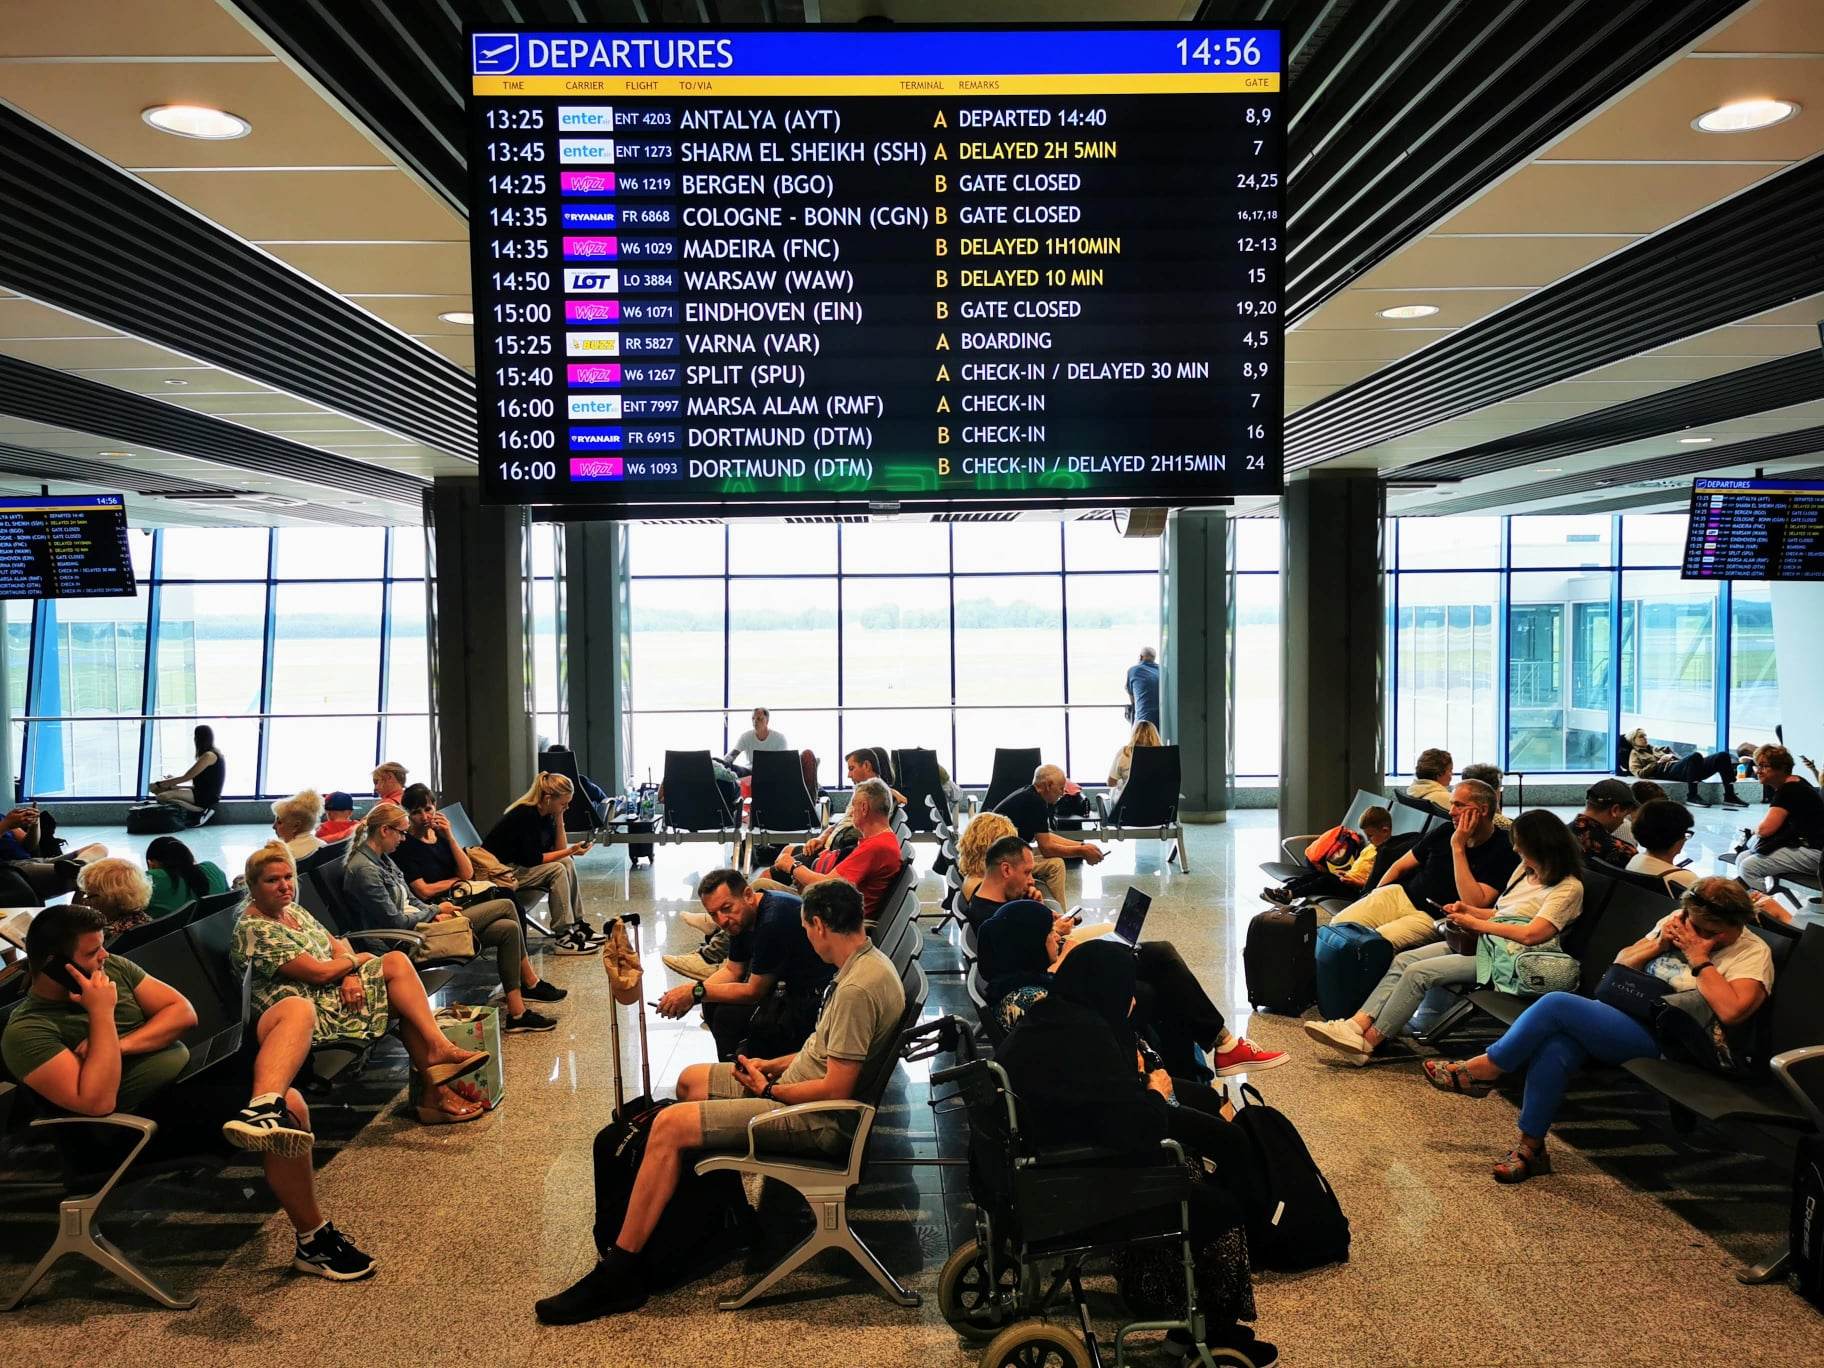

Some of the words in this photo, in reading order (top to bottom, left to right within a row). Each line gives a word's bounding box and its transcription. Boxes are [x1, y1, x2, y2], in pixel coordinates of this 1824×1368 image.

[529, 39, 732, 68] DEPARTURES
[1177, 38, 1260, 65] 14:56
[502, 81, 524, 90] TIME
[565, 81, 604, 90] CARRIER
[625, 81, 659, 90] FLIGHT
[679, 80, 713, 91] TO/VIA
[900, 81, 944, 90] TERMINAL
[959, 80, 1000, 90] REMARKS
[1245, 78, 1270, 87] GATE
[487, 110, 543, 128] 13:25
[615, 113, 639, 124] ENT
[643, 114, 671, 124] 4203
[680, 110, 776, 129] ANTALYA
[785, 110, 840, 133] (AYT)
[934, 110, 947, 128] A
[960, 110, 1051, 127] DEPARTED
[1059, 109, 1106, 126] 14:40
[1246, 108, 1271, 125] 8,9
[488, 143, 544, 161] 13:45
[616, 146, 640, 157] ENT
[645, 146, 672, 157] 1273
[682, 143, 752, 161] SHARM
[760, 143, 784, 161] EL
[791, 143, 864, 161] SHEIKH
[874, 142, 926, 165] (SSH)
[934, 143, 947, 160] A
[960, 142, 1038, 159] DELAYED
[1045, 142, 1067, 158] 2H
[1075, 142, 1116, 158] 5MIN
[1254, 141, 1263, 155] 7
[489, 175, 545, 194] 14:25
[619, 179, 638, 189] W6
[643, 179, 670, 189] 1219
[683, 175, 764, 194] BERGEN
[774, 175, 833, 198] (BGO)
[936, 175, 947, 192] B
[960, 175, 1007, 191] GATE
[1013, 174, 1080, 191] CLOSED
[1238, 174, 1277, 190] 24,25
[491, 208, 547, 226] 14:35
[570, 213, 614, 221] RYANAIR
[623, 211, 638, 222] FR
[642, 211, 670, 222] 6868
[683, 208, 781, 226] COLOGNE
[805, 207, 860, 225] BONN
[870, 207, 928, 229] (CGN)
[936, 207, 947, 224] B
[960, 207, 1007, 223] GATE
[1013, 206, 1080, 223] CLOSED
[1238, 211, 1277, 220] 16,17,18
[492, 240, 548, 258] 14:35
[621, 243, 640, 254] W6
[645, 243, 672, 254] 1029
[684, 239, 775, 258] MADEIRA
[784, 239, 839, 262] (FNC)
[936, 239, 947, 256] B
[961, 238, 1038, 255] DELAYED
[1046, 238, 1120, 254] 1H10MIN
[1238, 238, 1276, 251] 12-13
[493, 272, 549, 290] 14:50
[573, 275, 611, 289] LOT
[624, 275, 640, 286] LO
[644, 275, 672, 286] 3884
[684, 271, 776, 290] WARSAW
[785, 271, 853, 293] (WAW)
[937, 270, 948, 287] B
[961, 270, 1038, 286] DELAYED
[1046, 270, 1065, 286] 10
[1071, 269, 1103, 286] MIN
[1249, 268, 1265, 282] 15
[494, 304, 551, 322] 15:00
[623, 307, 642, 317] W6
[647, 307, 672, 317] 1071
[686, 302, 804, 321] EINDHOVEN
[814, 302, 862, 324] (EIN)
[937, 302, 948, 319] B
[961, 302, 1008, 318] GATE
[1014, 301, 1081, 317] CLOSED
[1237, 301, 1276, 317] 19,20
[496, 336, 551, 354] 15:25
[582, 339, 616, 350] BUZZ
[626, 338, 641, 349] RR
[646, 338, 673, 349] 5827
[686, 334, 756, 353] VARNA
[764, 334, 819, 356] (VAR)
[936, 333, 949, 350] A
[962, 333, 1051, 349] BOARDING
[1243, 331, 1268, 348] 4,5
[497, 367, 553, 385] 15:40
[625, 370, 643, 380] W6
[648, 369, 675, 380] 1267
[687, 366, 743, 384] SPLIT
[751, 365, 804, 388] (SPU)
[936, 364, 950, 381] A
[962, 364, 1044, 380] CHECK-IN
[1068, 363, 1145, 379] DELAYED
[1152, 363, 1171, 378] 30
[1177, 362, 1208, 378] MIN
[1244, 363, 1268, 379] 8,9
[498, 399, 553, 417] 16:00
[623, 401, 648, 412] ENT
[651, 401, 678, 411] 7997
[687, 397, 756, 415] MARSA
[763, 396, 818, 414] ALAM
[827, 396, 883, 418] (RMF)
[937, 396, 950, 412] A
[962, 395, 1044, 411] CHECK-IN
[1251, 394, 1260, 407] 7
[499, 430, 554, 448] 16:00
[577, 434, 620, 443] RYANAIR
[629, 432, 643, 443] FR
[647, 432, 675, 443] 6915
[689, 428, 805, 446] DORTMUND
[814, 427, 872, 450] (DTM)
[939, 427, 949, 443] B
[962, 426, 1044, 442] CHECK-IN
[1248, 425, 1264, 438] 16
[500, 462, 555, 480] 16:00
[627, 464, 645, 474] W6
[651, 463, 677, 474] 1093
[690, 459, 805, 480] DORTMUND
[813, 458, 873, 481] (DTM)
[938, 458, 950, 475] B
[962, 456, 1045, 474] CHECK-IN
[1068, 456, 1145, 473] DELAYED
[1151, 455, 1226, 472] 2H15MIN
[1246, 455, 1265, 470] 24
[1707, 480, 1750, 489] DEPARTURES
[96, 497, 118, 505] 14:56
